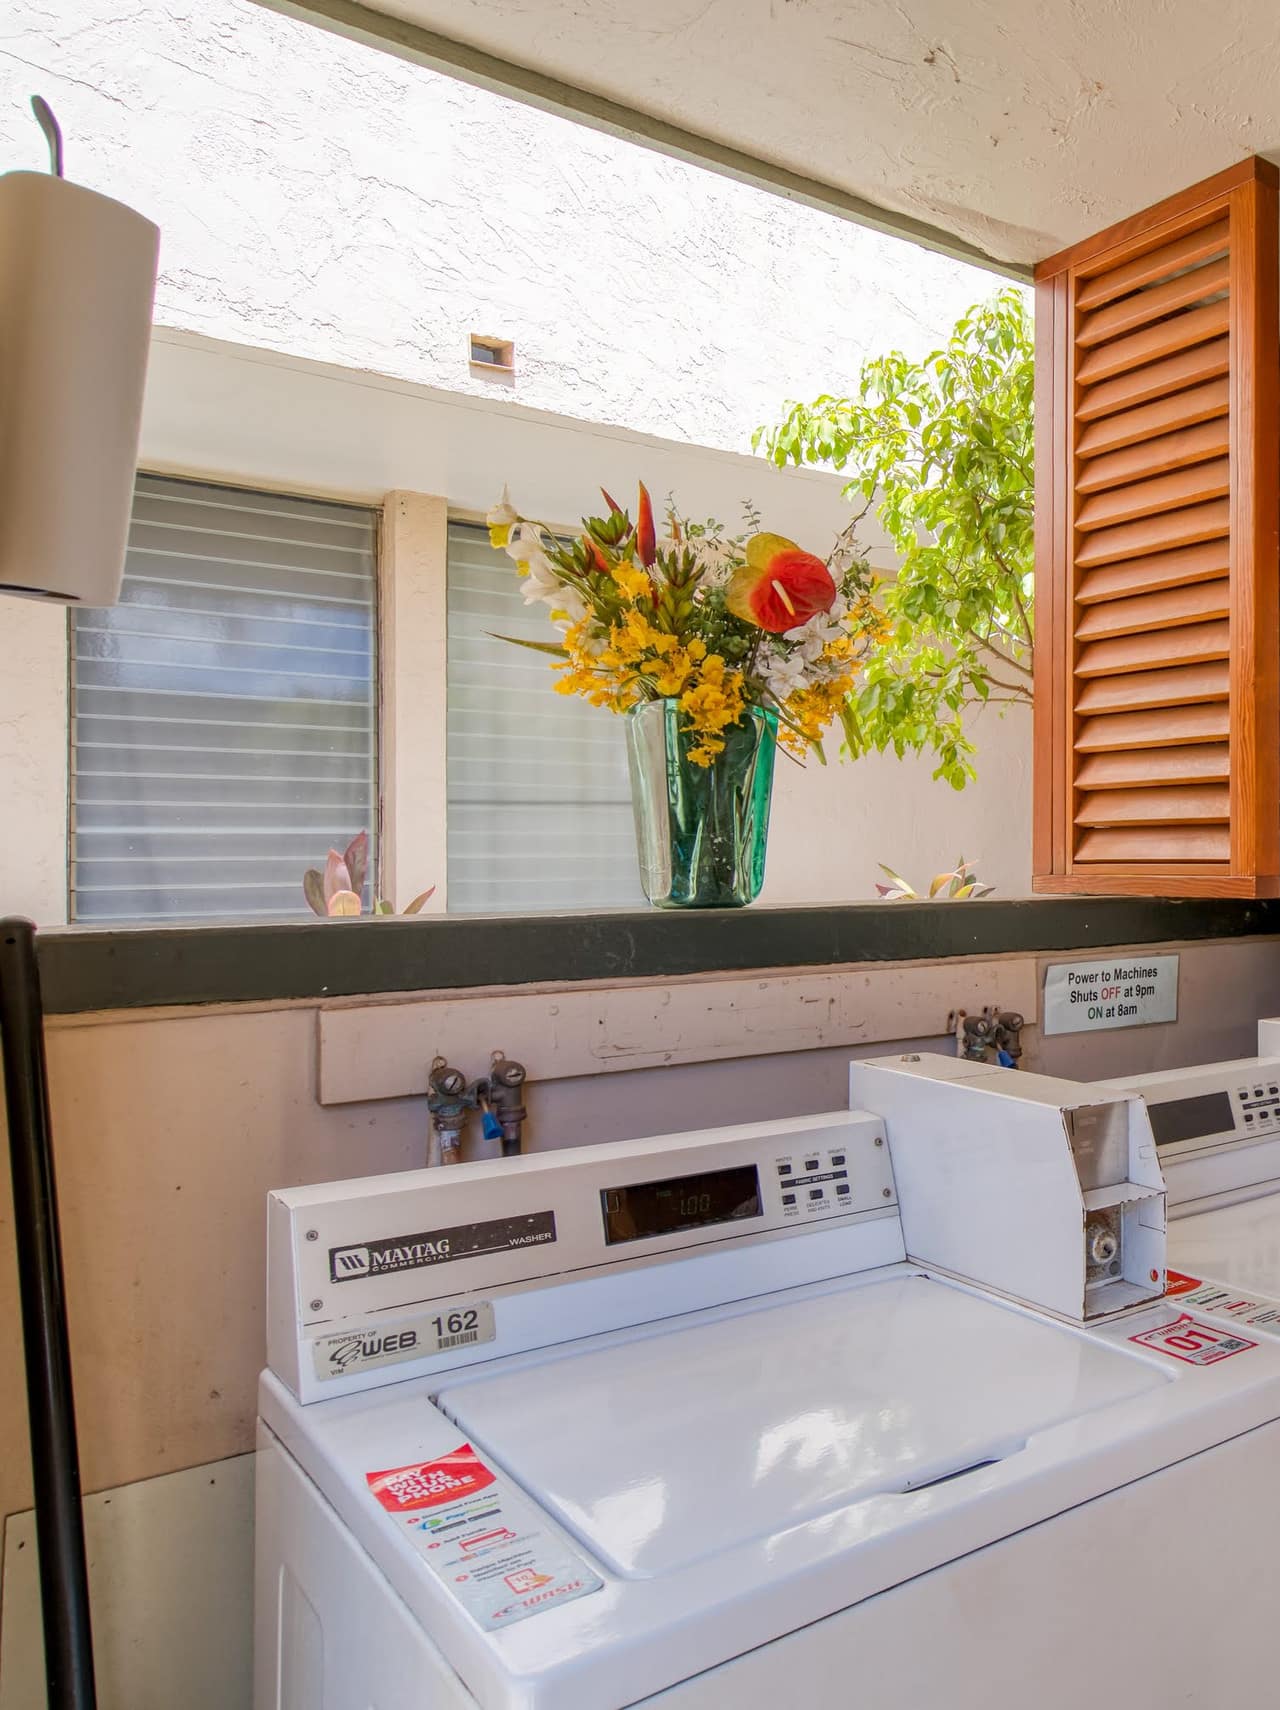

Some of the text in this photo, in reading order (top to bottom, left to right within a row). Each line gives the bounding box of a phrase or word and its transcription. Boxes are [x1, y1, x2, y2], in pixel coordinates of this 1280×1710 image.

[1068, 966, 1158, 985] Power to Machines
[1070, 984, 1155, 1003] Shuts OFF at 9pm
[1088, 1004, 1137, 1020] ON at 8am
[508, 1232, 552, 1246] WASHER
[371, 1253, 450, 1272] COMMERCIAL
[372, 1239, 450, 1266] MAYTAG
[431, 1309, 479, 1337] 162
[328, 1330, 377, 1346] PROPERTY OF
[362, 1331, 417, 1357] WEB
[1164, 1330, 1220, 1351] 01
[330, 1368, 344, 1376] VIM
[387, 1470, 445, 1491] WITH
[391, 1475, 453, 1497] YOUR
[398, 1475, 476, 1504] PHONE
